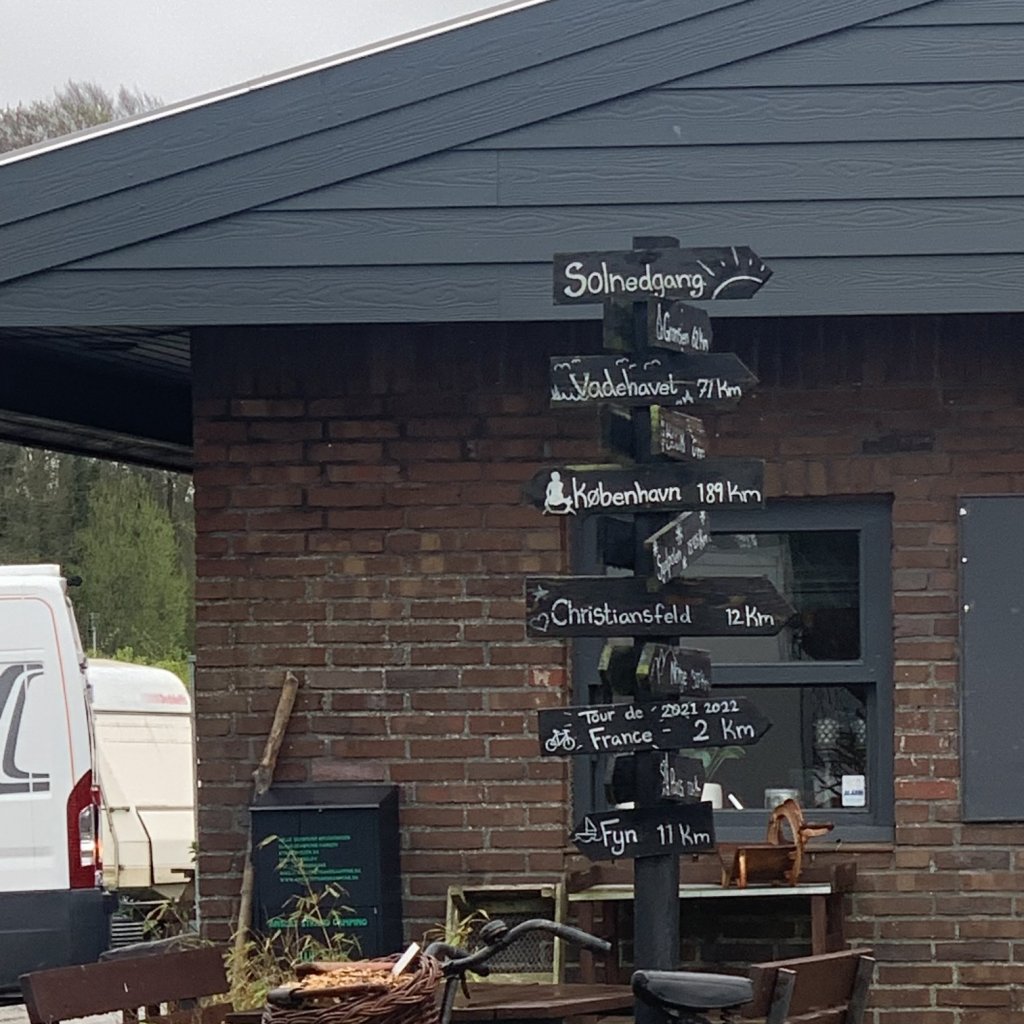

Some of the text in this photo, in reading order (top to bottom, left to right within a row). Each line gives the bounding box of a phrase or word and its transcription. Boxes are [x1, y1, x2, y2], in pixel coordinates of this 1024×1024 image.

[563, 261, 706, 299] Solnedgang
[569, 368, 678, 399] Vadehavet
[571, 477, 682, 510] København
[697, 482, 723, 503] 189
[551, 598, 692, 627] Christiansfeld
[578, 700, 740, 724] Tour de 2021 2022
[588, 717, 755, 750] France 2 Km
[600, 817, 711, 856] Fyn 11 Km
